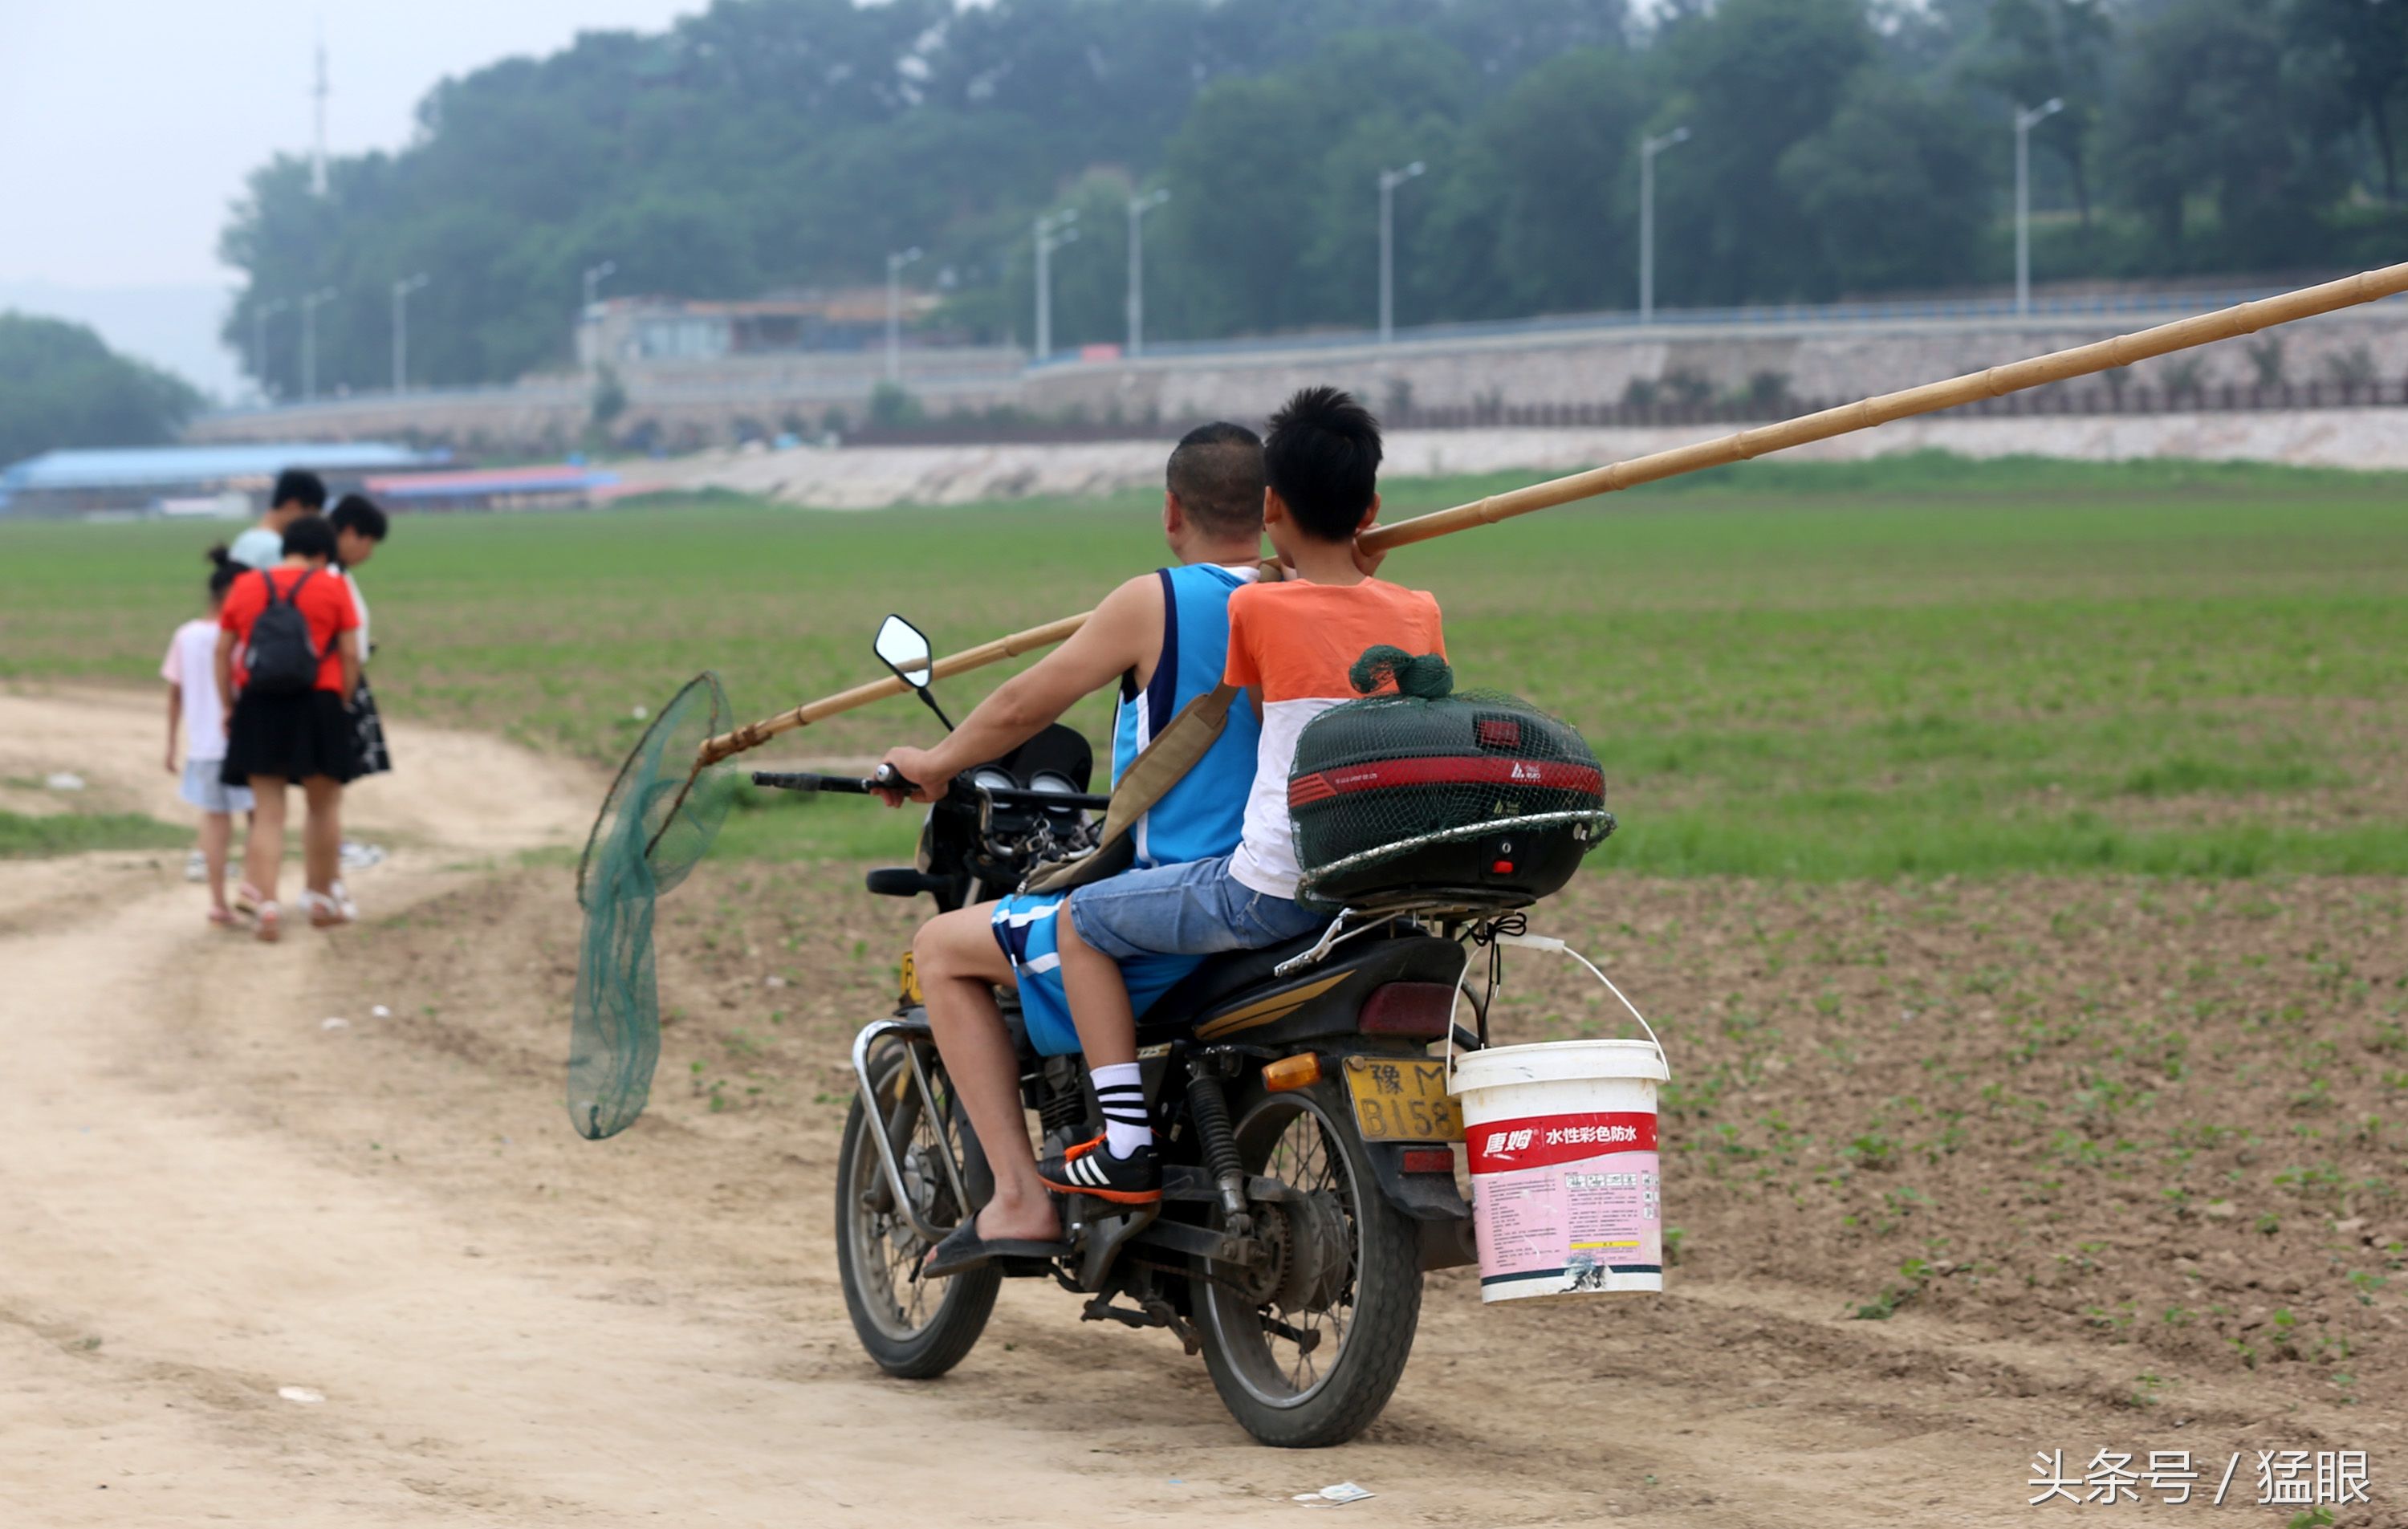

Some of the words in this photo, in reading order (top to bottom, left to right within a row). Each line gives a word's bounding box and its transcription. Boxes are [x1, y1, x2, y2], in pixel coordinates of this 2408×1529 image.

[1361, 1098, 1462, 1137] B158
[1546, 1125, 1637, 1145] 水性彩色防水
